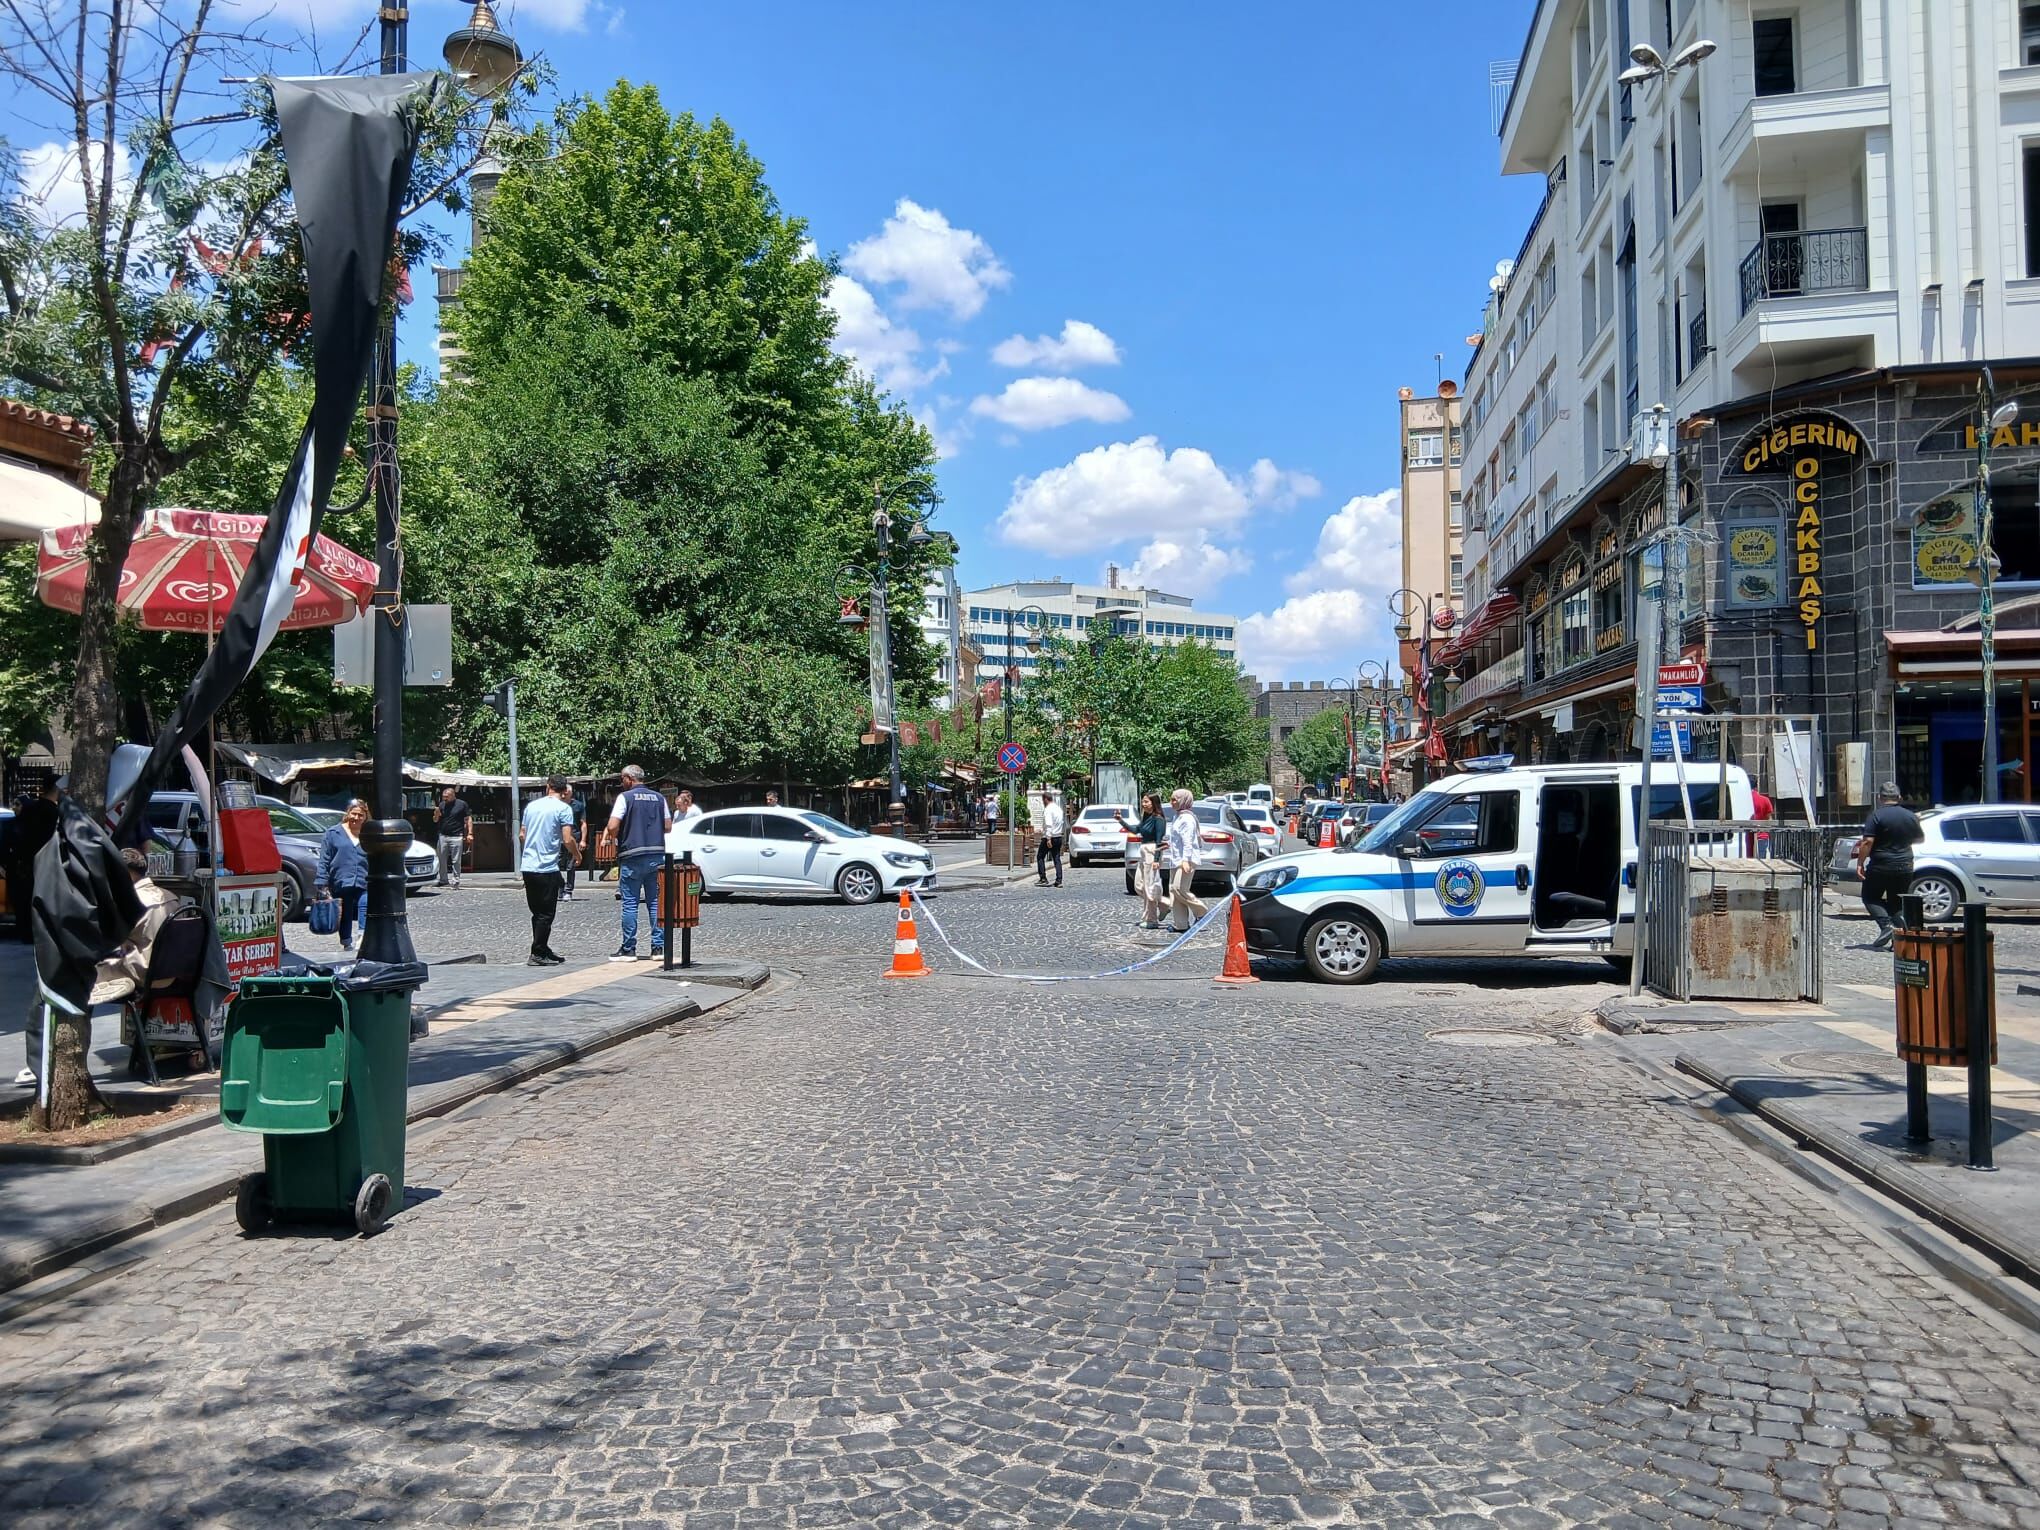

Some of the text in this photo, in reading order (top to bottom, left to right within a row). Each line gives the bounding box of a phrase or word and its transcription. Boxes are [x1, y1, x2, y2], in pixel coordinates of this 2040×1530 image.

[1743, 421, 1858, 472] CİĞERİM
[1795, 457, 1823, 650] OCAKBAŞI
[1435, 614, 1455, 625] KING
[1444, 861, 1474, 872] ZABITA
[245, 942, 275, 964] ŞERBET
